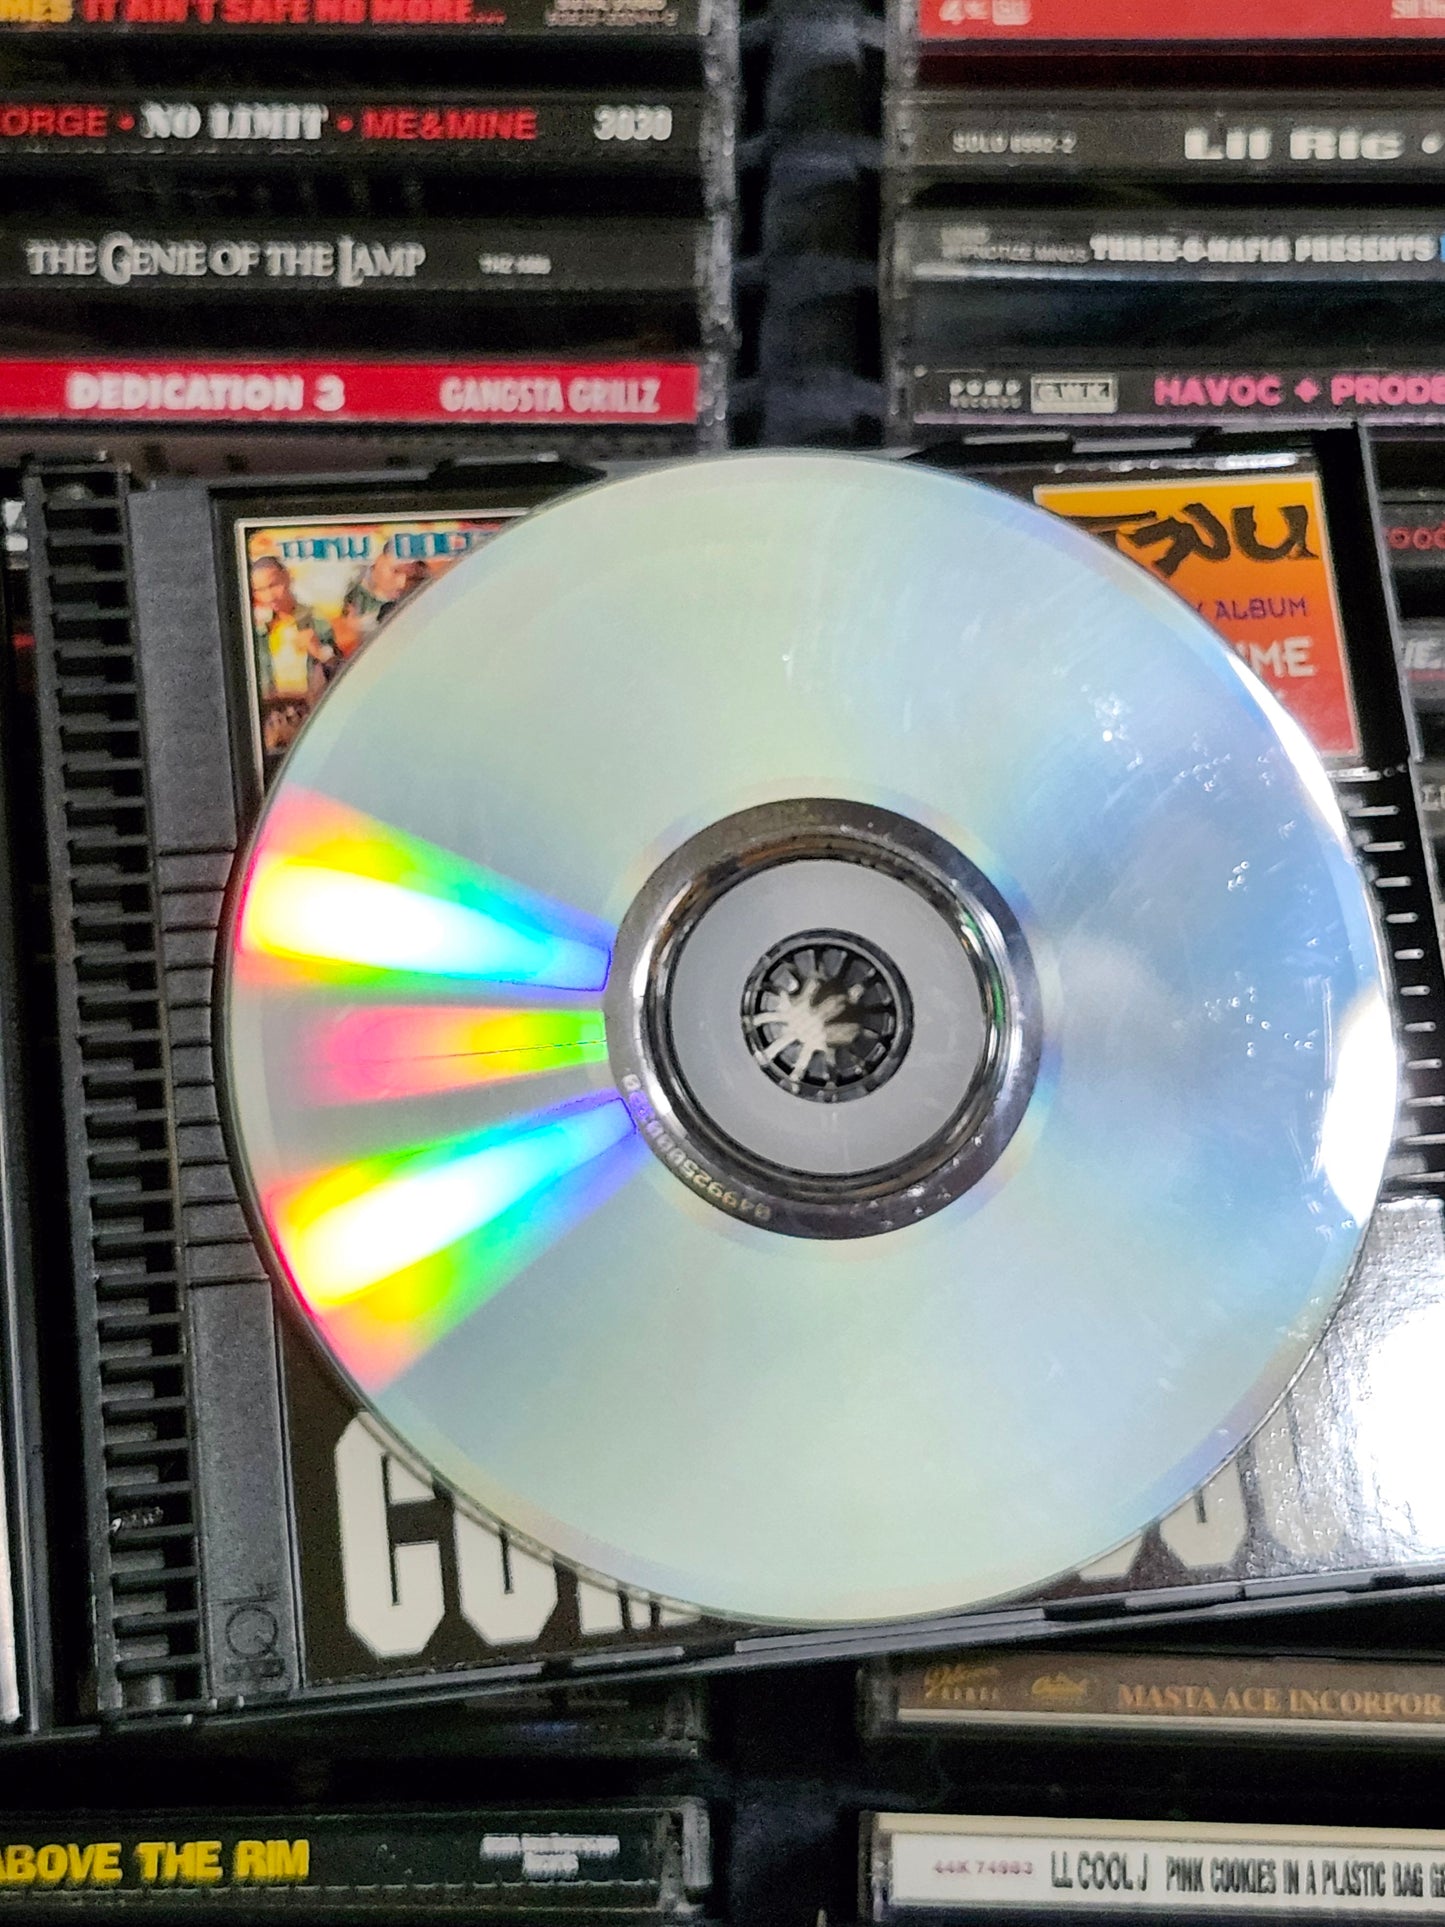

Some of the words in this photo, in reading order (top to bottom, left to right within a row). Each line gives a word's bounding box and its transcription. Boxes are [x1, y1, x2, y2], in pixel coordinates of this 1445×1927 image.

[141, 101, 201, 139] NO
[208, 102, 328, 140] LIMIT
[361, 107, 538, 141] ME&MINE
[26, 238, 98, 277] THE
[100, 231, 207, 286] GENIE
[208, 240, 260, 277] OF
[263, 239, 335, 277] THE
[337, 233, 427, 289] LAMP
[1295, 234, 1436, 263] PRESENTS
[66, 372, 305, 412] DEDICATION
[314, 374, 345, 412] 3
[439, 375, 565, 414] GANGSTA
[567, 376, 662, 415] GRILLZ
[1154, 374, 1282, 407] HAVOC
[1215, 597, 1308, 622] ALBUM
[1118, 1683, 1218, 1710] MASTA
[1222, 1686, 1282, 1713] ACE
[135, 1840, 223, 1882] THE
[235, 1838, 311, 1881] RIM
[1050, 1849, 1074, 1890] LL
[1076, 1850, 1133, 1892] COOL
[1136, 1852, 1149, 1892] J
[1165, 1854, 1204, 1894] PINK
[1209, 1856, 1278, 1896] COOKIES
[1282, 1858, 1301, 1896] IN
[1305, 1859, 1318, 1896] A
[1321, 1860, 1387, 1898] PLASTIC
[1393, 1861, 1425, 1899] BAG
